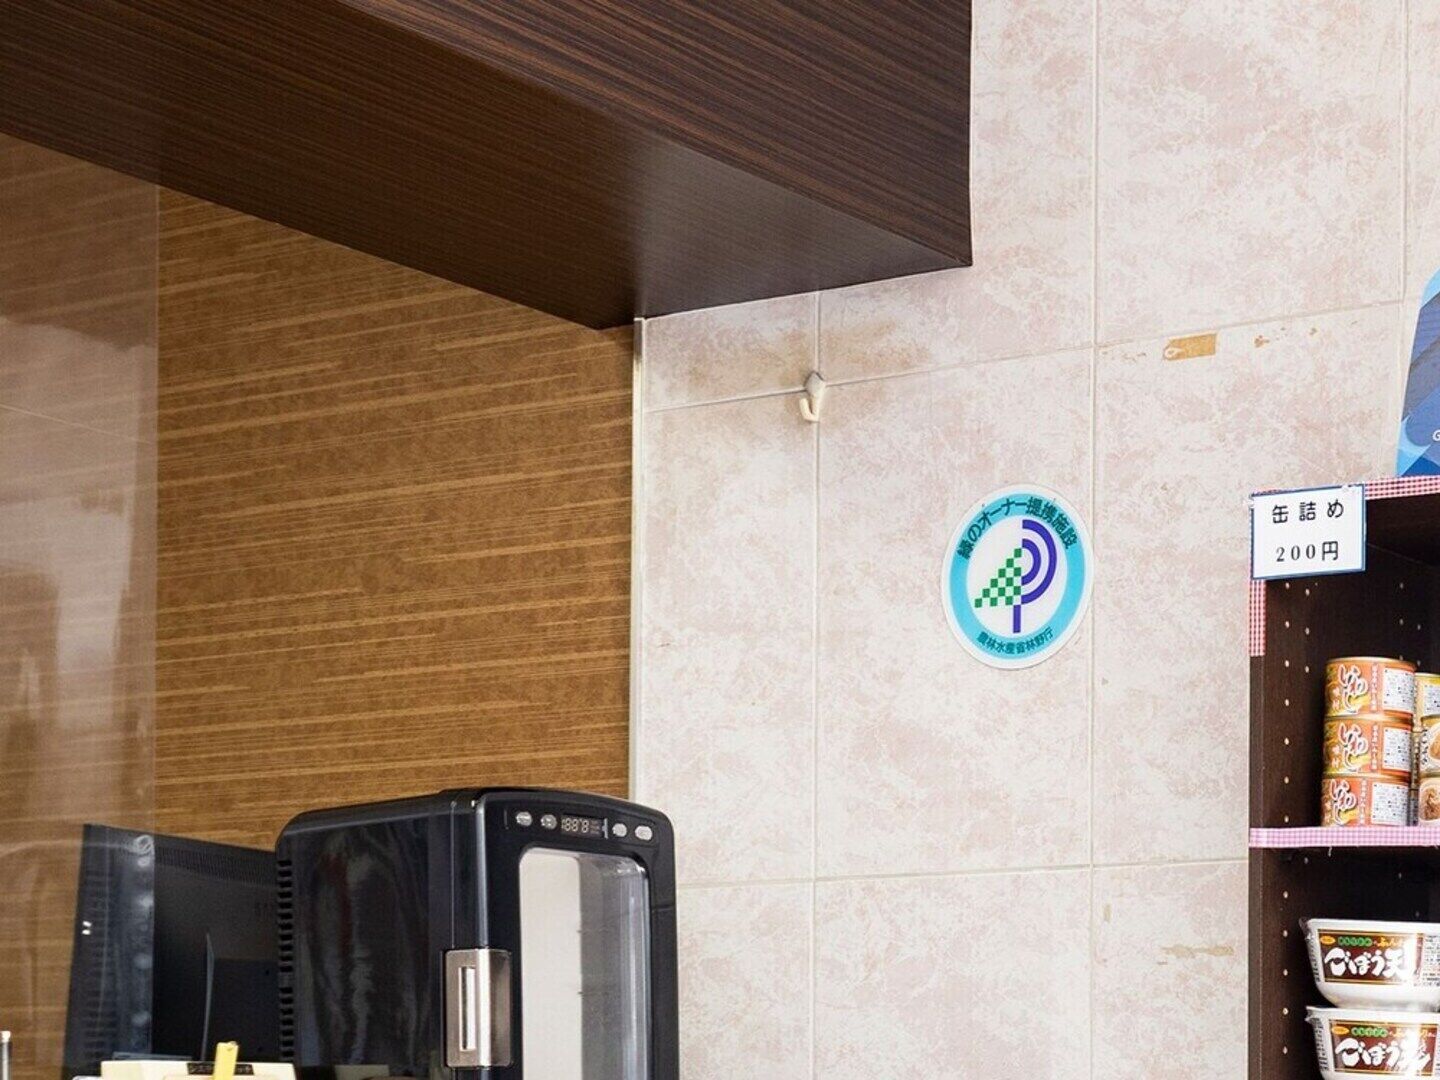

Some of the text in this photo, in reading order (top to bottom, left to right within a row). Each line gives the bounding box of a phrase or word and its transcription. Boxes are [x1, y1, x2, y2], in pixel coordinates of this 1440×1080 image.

[1272, 499, 1344, 523] 缶詰め
[1276, 541, 1339, 562] 200円
